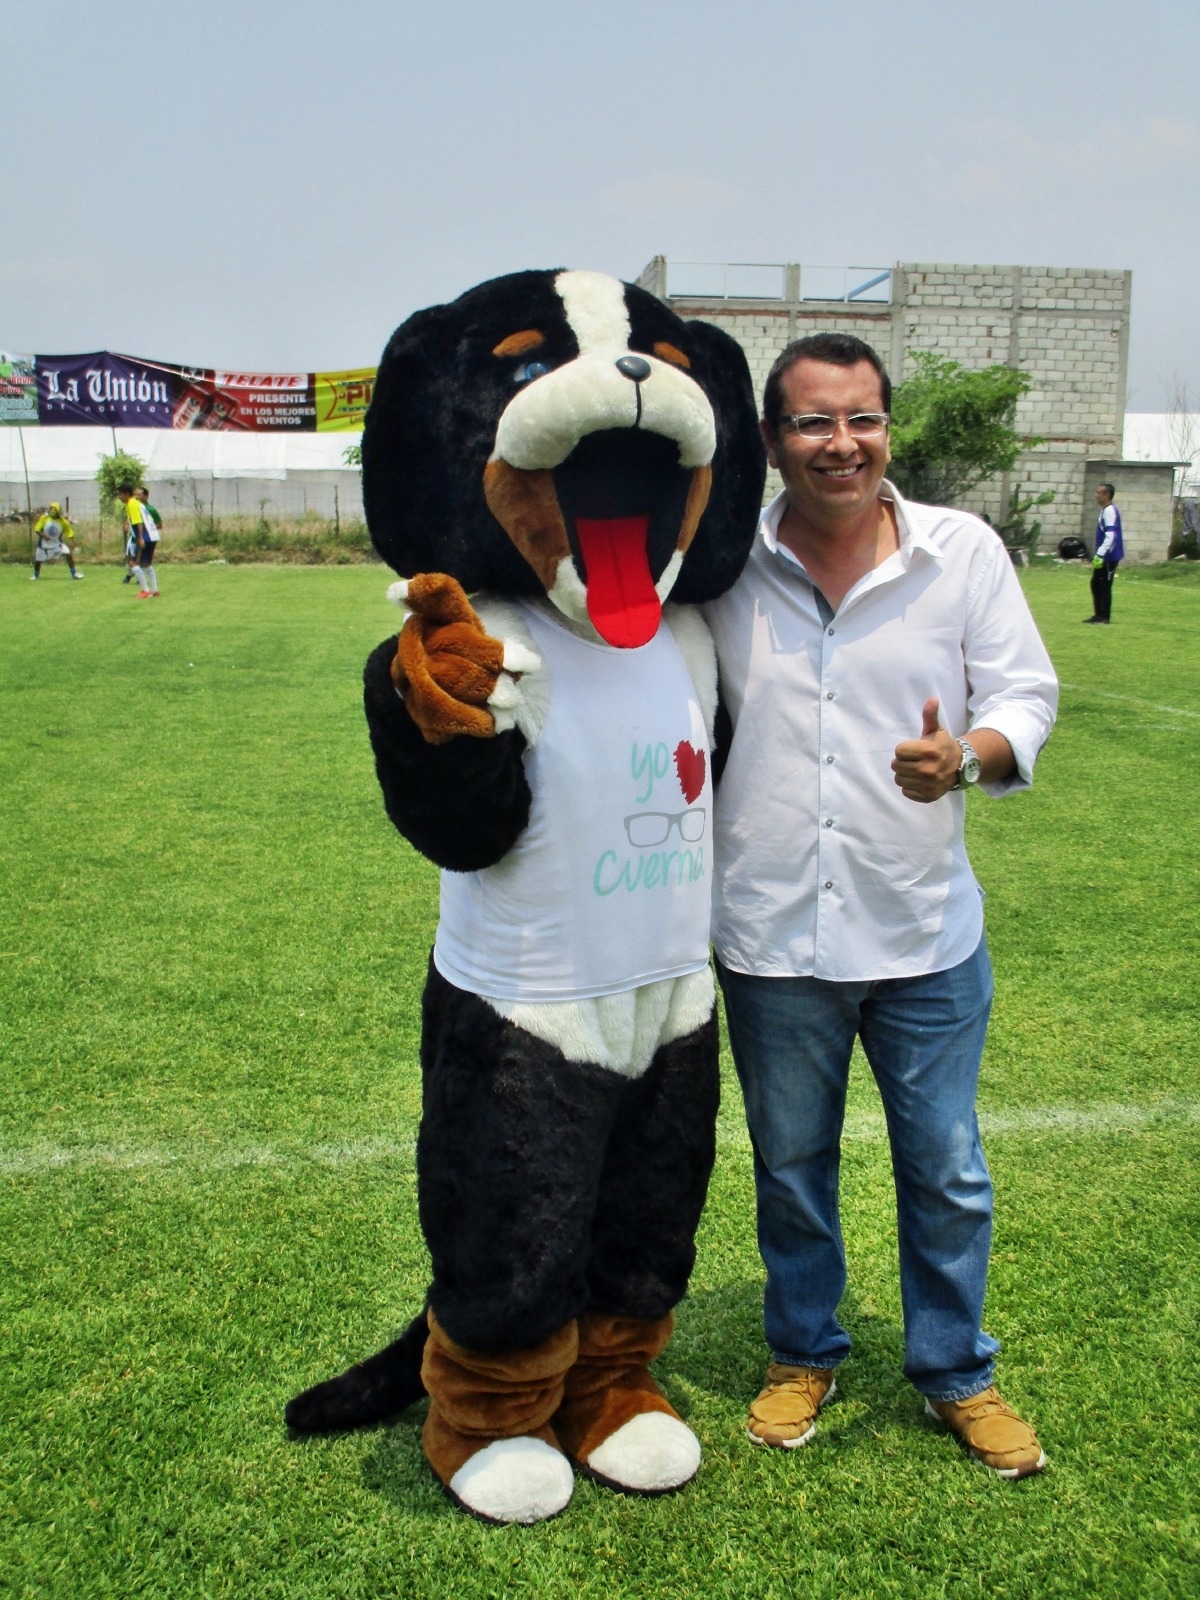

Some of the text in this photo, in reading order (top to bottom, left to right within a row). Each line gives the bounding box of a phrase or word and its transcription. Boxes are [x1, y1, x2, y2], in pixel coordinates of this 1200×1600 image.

[42, 369, 169, 403] La Unión
[222, 373, 301, 387] TECATE
[249, 393, 306, 403] PRESENTE
[241, 407, 316, 416] EN LOS MEJORES
[256, 416, 301, 425] EVENTOS
[630, 741, 670, 803] yo
[593, 846, 705, 896] Cuerna
